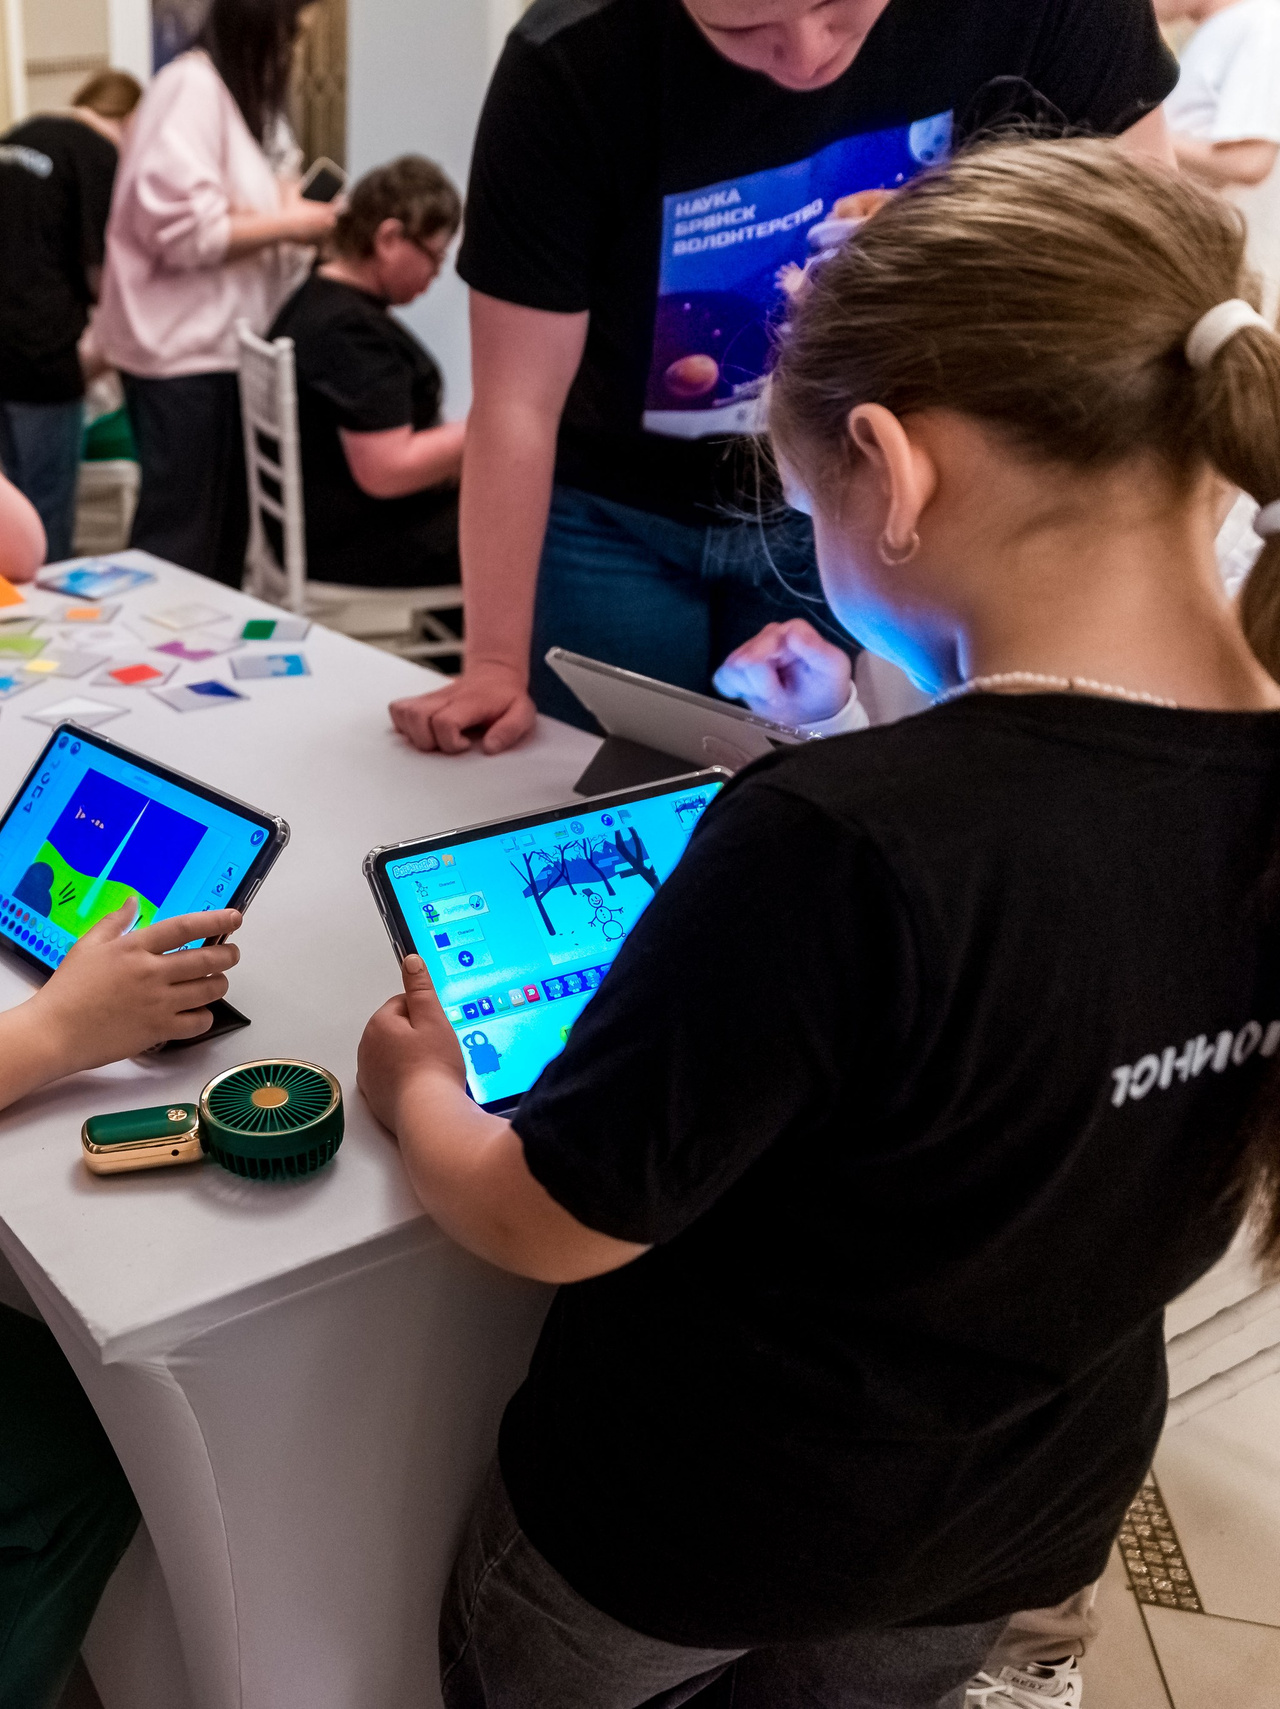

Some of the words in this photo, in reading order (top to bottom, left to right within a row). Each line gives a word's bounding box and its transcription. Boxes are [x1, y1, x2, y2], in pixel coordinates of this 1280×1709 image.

[675, 188, 741, 218] НАУКА
[672, 198, 823, 256] ВОЛОНТЕРСТВО
[674, 204, 757, 237] БРЯНСК
